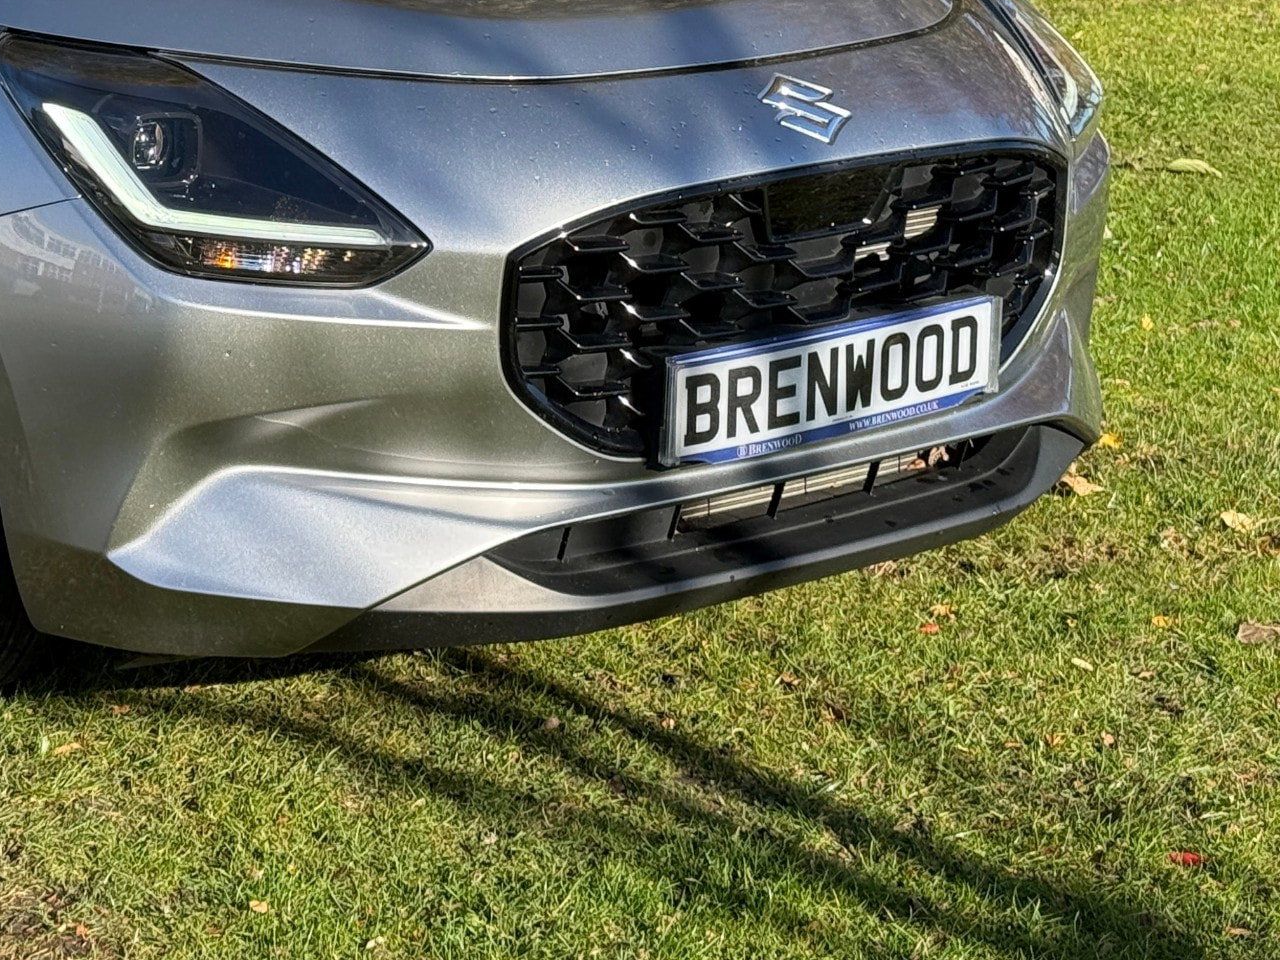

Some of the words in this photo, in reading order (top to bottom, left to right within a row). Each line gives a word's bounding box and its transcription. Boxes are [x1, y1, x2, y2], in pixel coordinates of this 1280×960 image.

[683, 315, 978, 448] BRENWOOD
[849, 400, 939, 431] WWW.BRENWOOD.CO.UK
[748, 433, 802, 456] BRENWOOD
